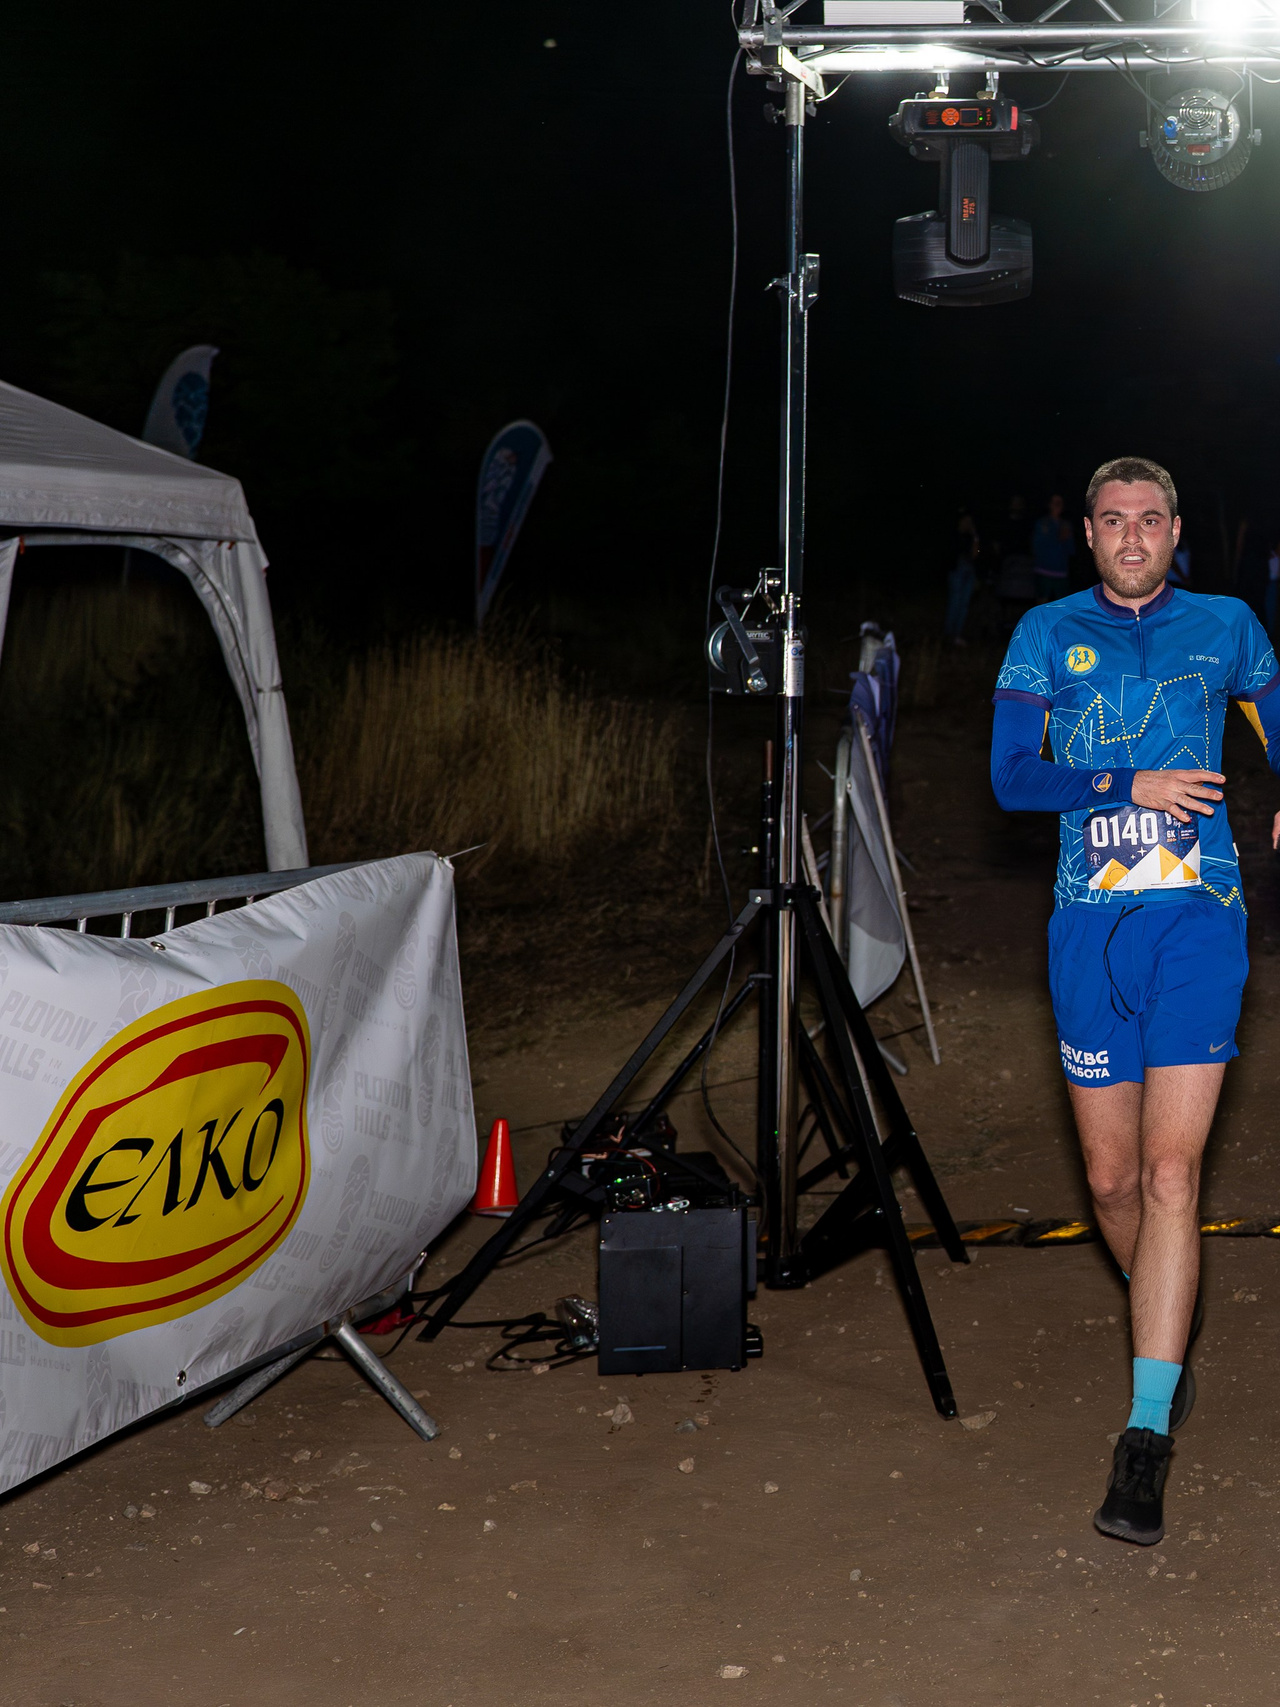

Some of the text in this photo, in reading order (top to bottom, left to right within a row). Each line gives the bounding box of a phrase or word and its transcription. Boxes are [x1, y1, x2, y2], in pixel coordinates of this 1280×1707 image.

[1090, 812, 1159, 848] 0140
[0, 989, 98, 1051] PLOVDIV
[0, 1034, 46, 1082] ILLS
[1060, 1040, 1109, 1066] DEV.BG
[1067, 1061, 1110, 1079] РАБОТА
[354, 1070, 412, 1113] PLOVDIV
[354, 1104, 391, 1141] HILLS
